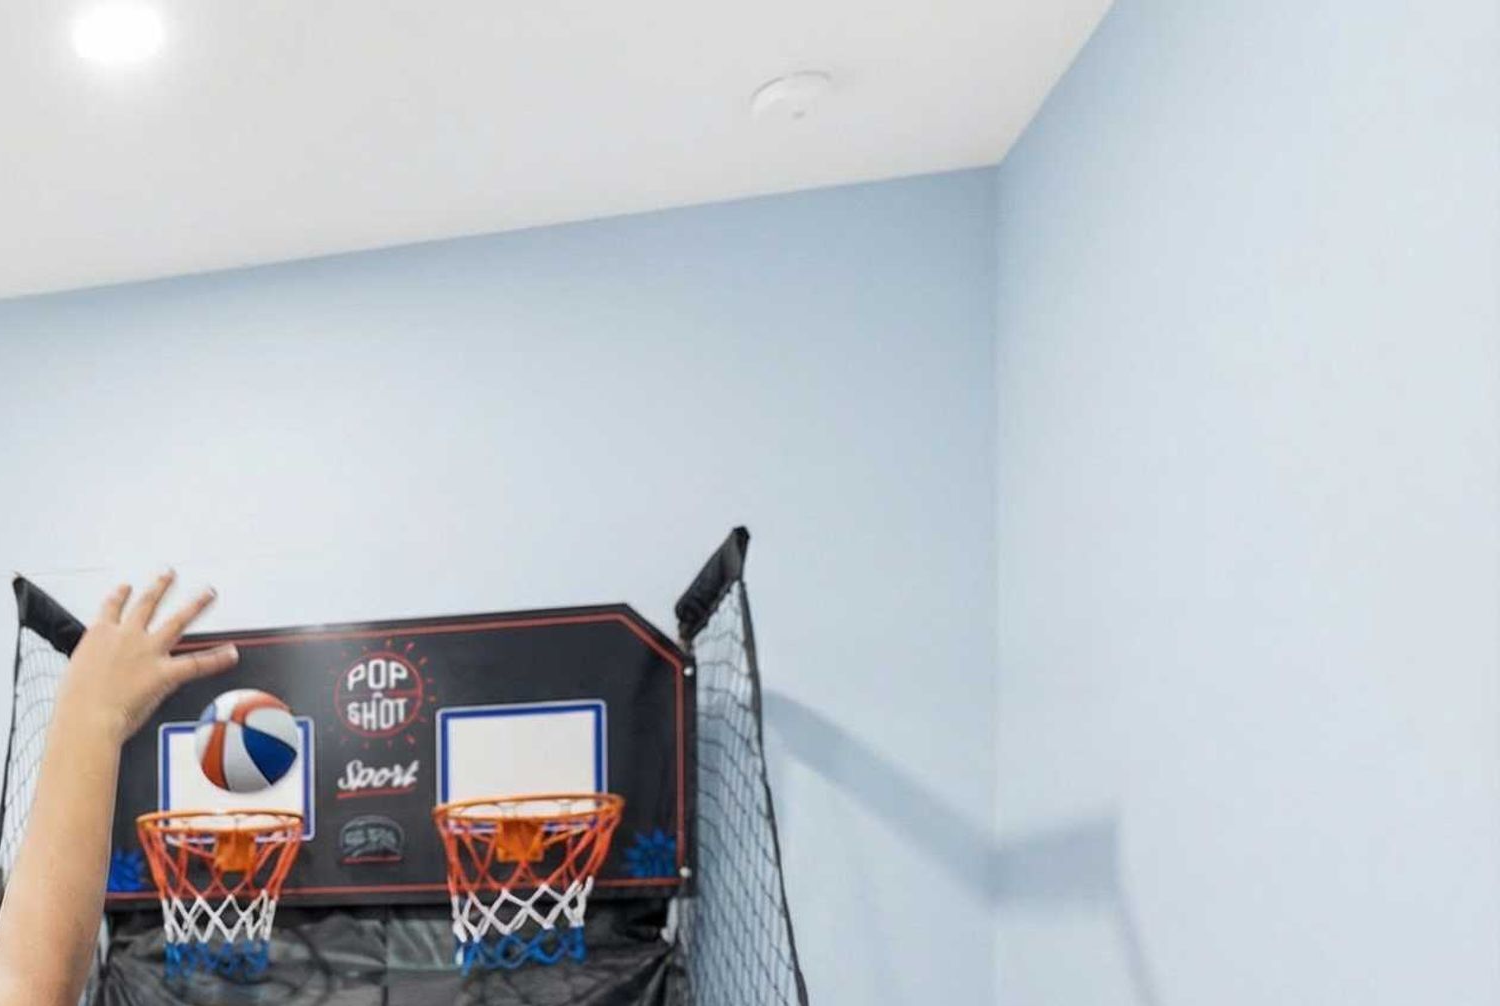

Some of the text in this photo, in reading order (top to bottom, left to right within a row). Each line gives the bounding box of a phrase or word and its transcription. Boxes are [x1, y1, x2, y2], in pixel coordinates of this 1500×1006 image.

[347, 658, 408, 691] POP
[347, 697, 408, 731] SHOT
[337, 759, 419, 791] Sport
